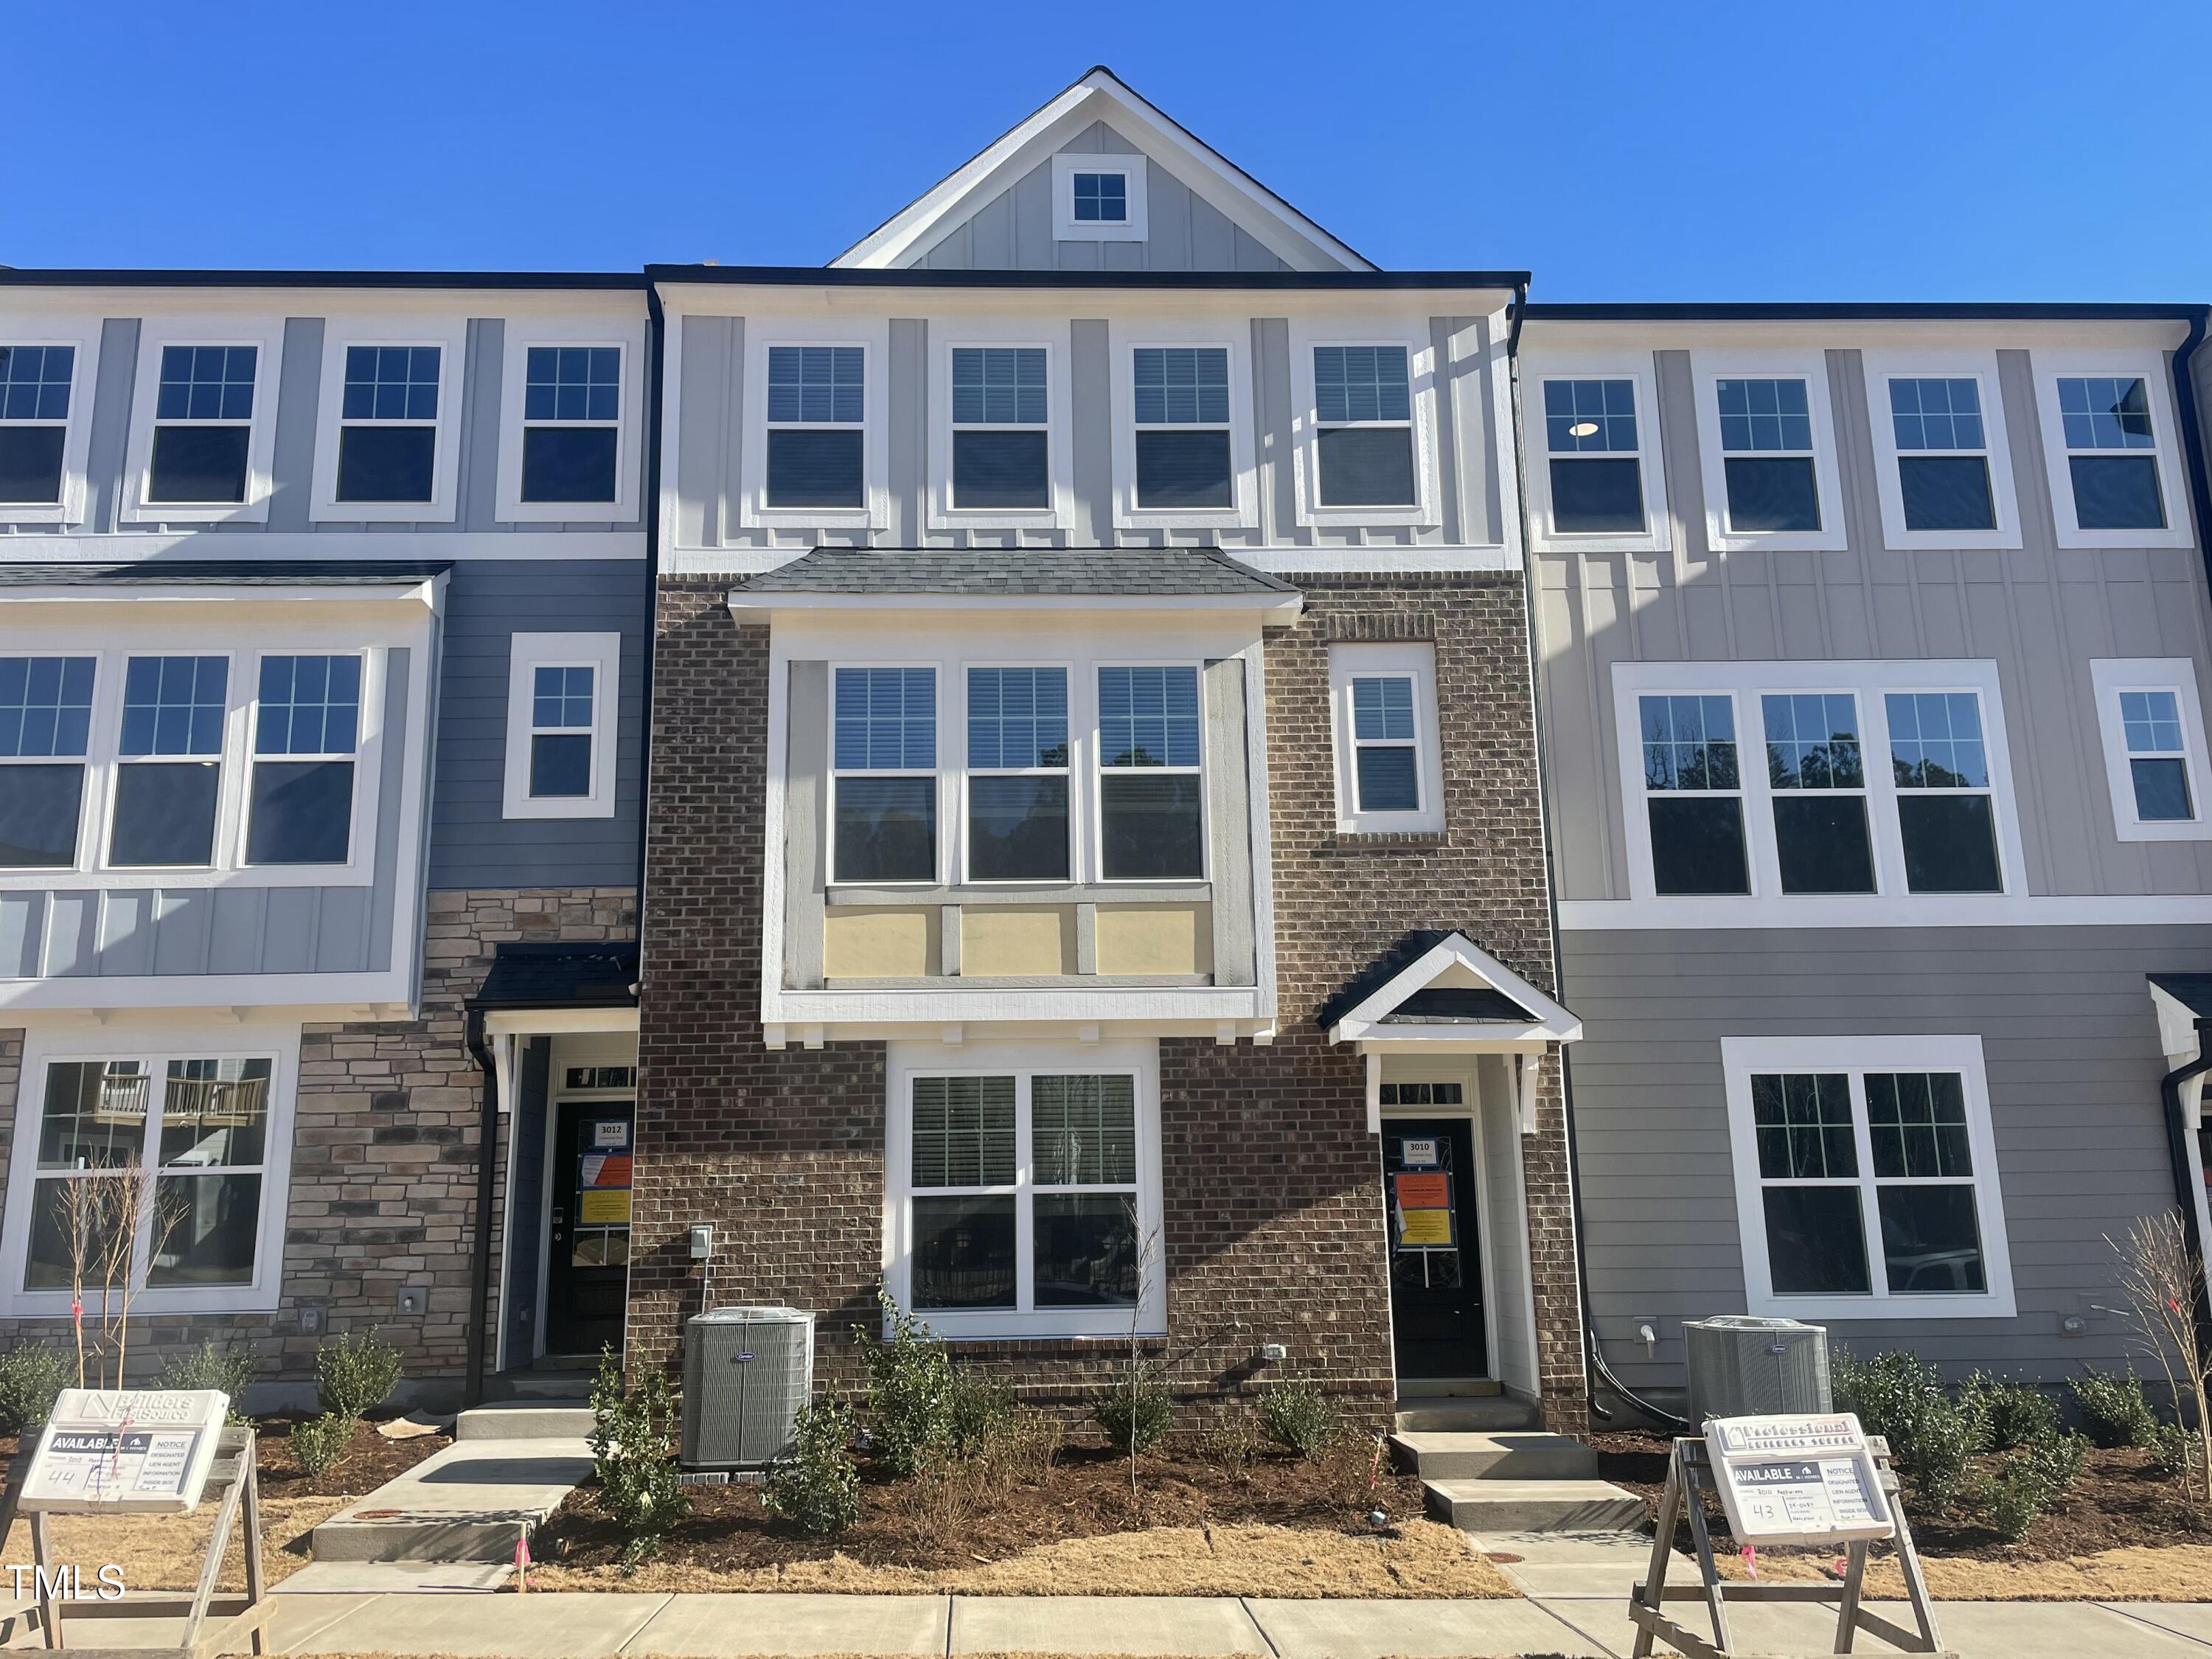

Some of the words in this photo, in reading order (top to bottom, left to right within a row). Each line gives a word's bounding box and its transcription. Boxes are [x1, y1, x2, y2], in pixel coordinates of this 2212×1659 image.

[1743, 1420, 1851, 1437] Professional
[52, 1437, 119, 1450] AVAILABLE
[48, 1470, 75, 1485] 44
[1734, 1468, 1793, 1482] AVAILABLE
[1826, 1467, 1855, 1475] NOTICE
[1753, 1504, 1775, 1519] 43
